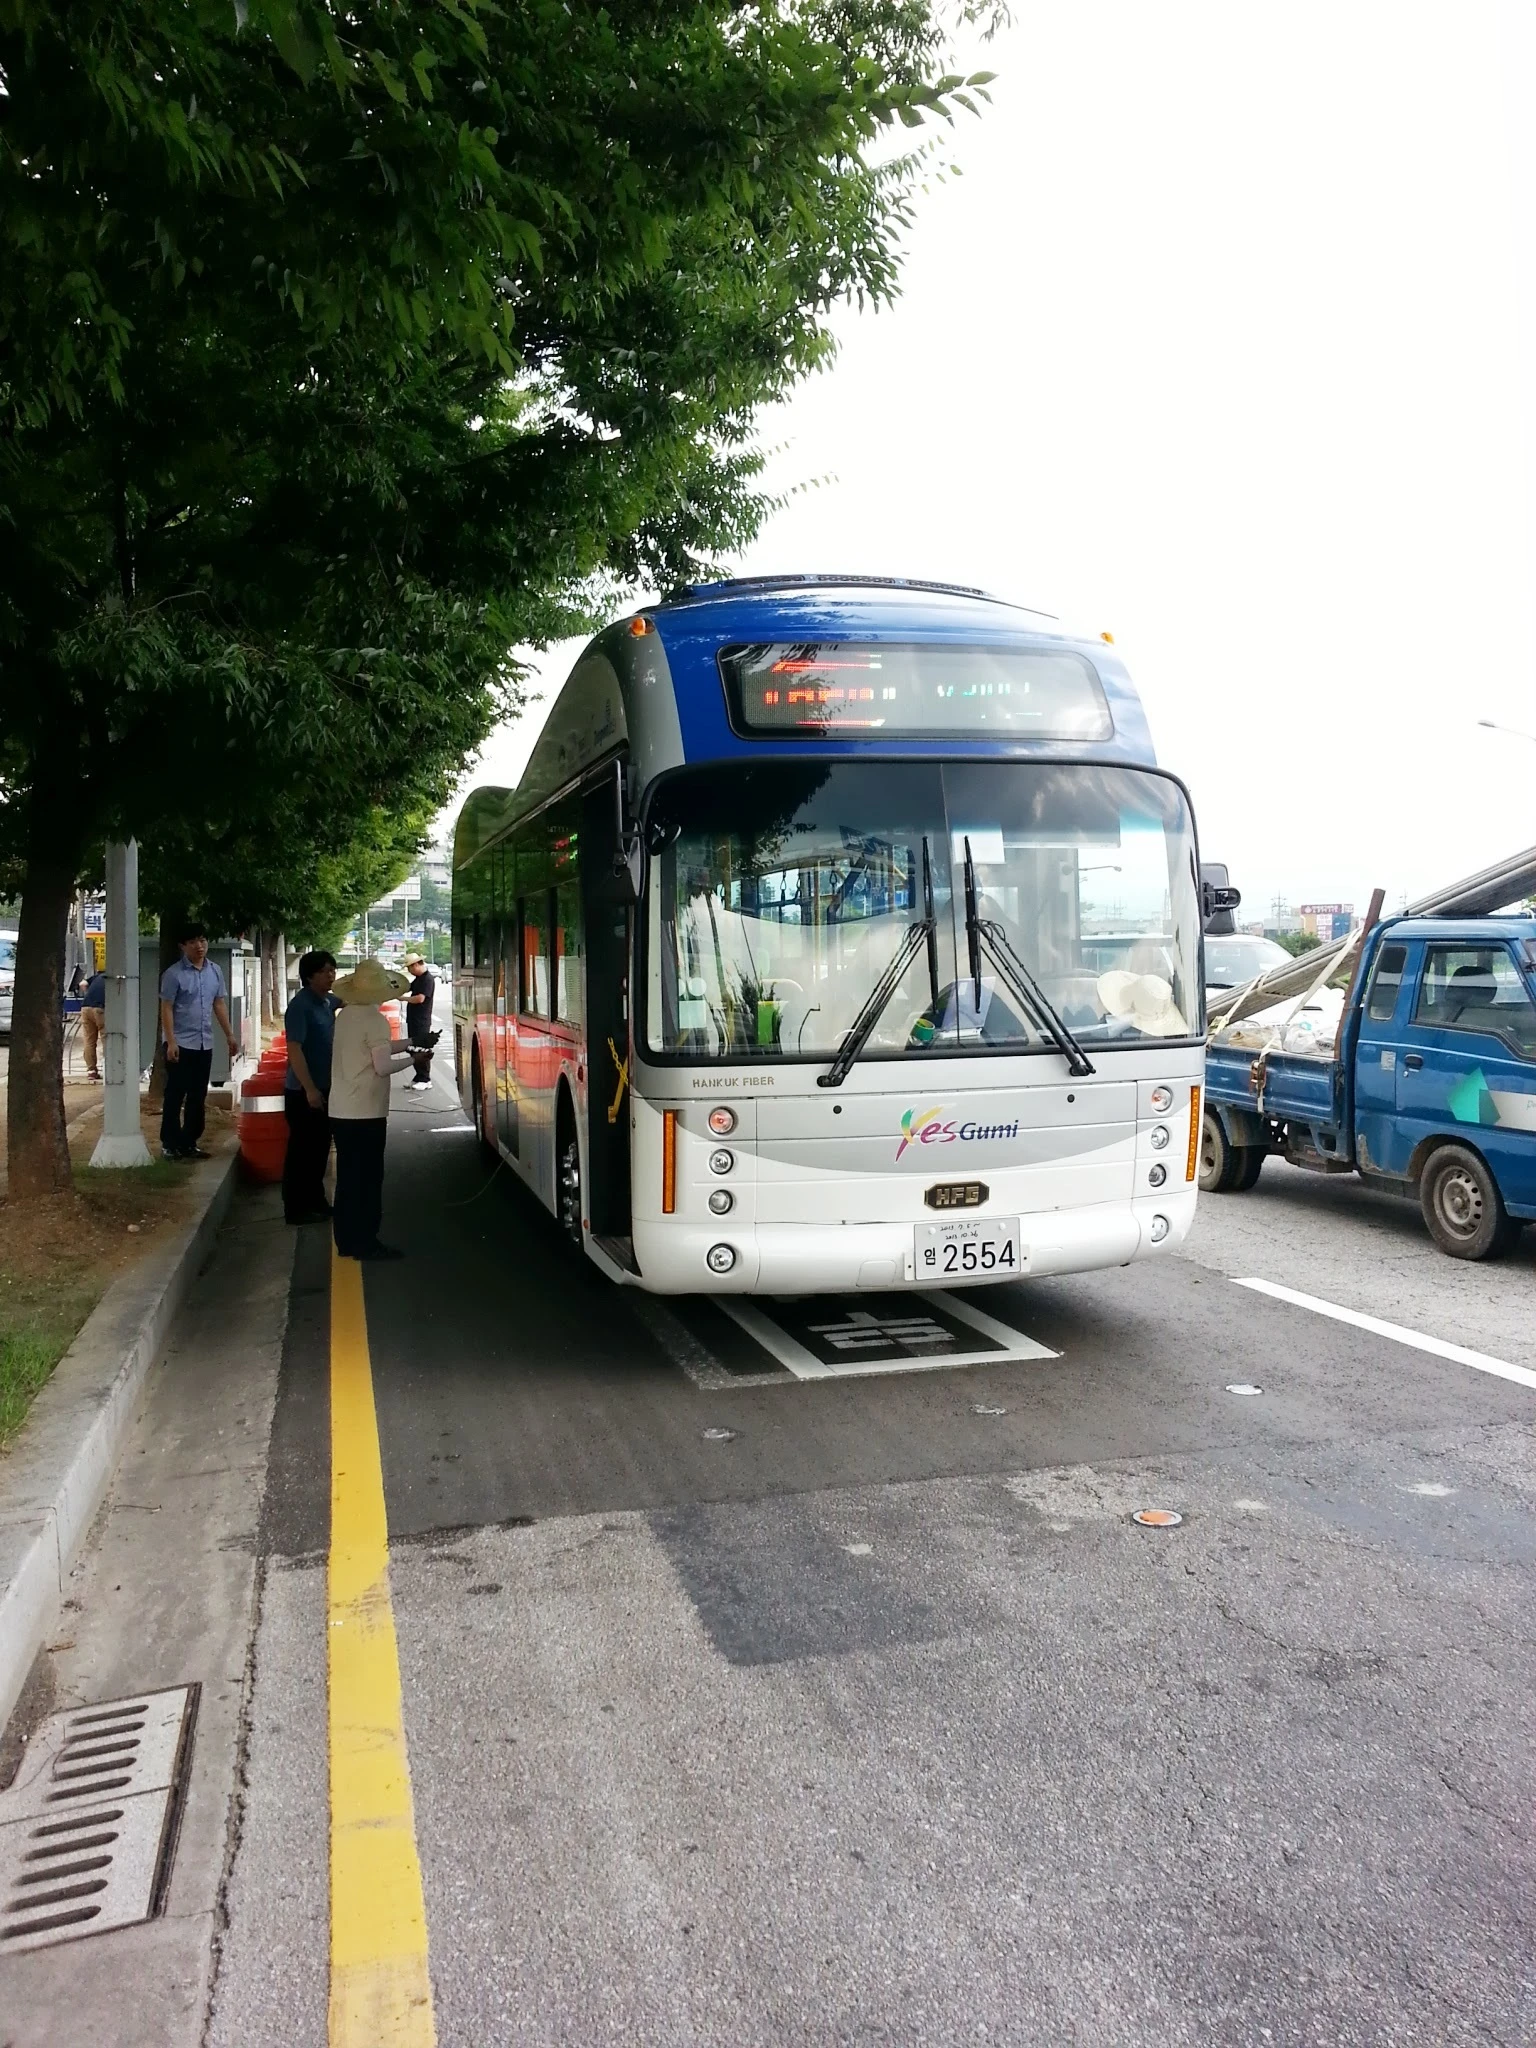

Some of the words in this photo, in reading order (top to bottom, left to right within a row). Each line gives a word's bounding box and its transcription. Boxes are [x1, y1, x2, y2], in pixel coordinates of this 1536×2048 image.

[692, 1078, 739, 1088] HANKUK
[743, 1076, 775, 1086] FIBER
[924, 1247, 936, 1265] 임
[943, 1239, 1016, 1272] 2554
